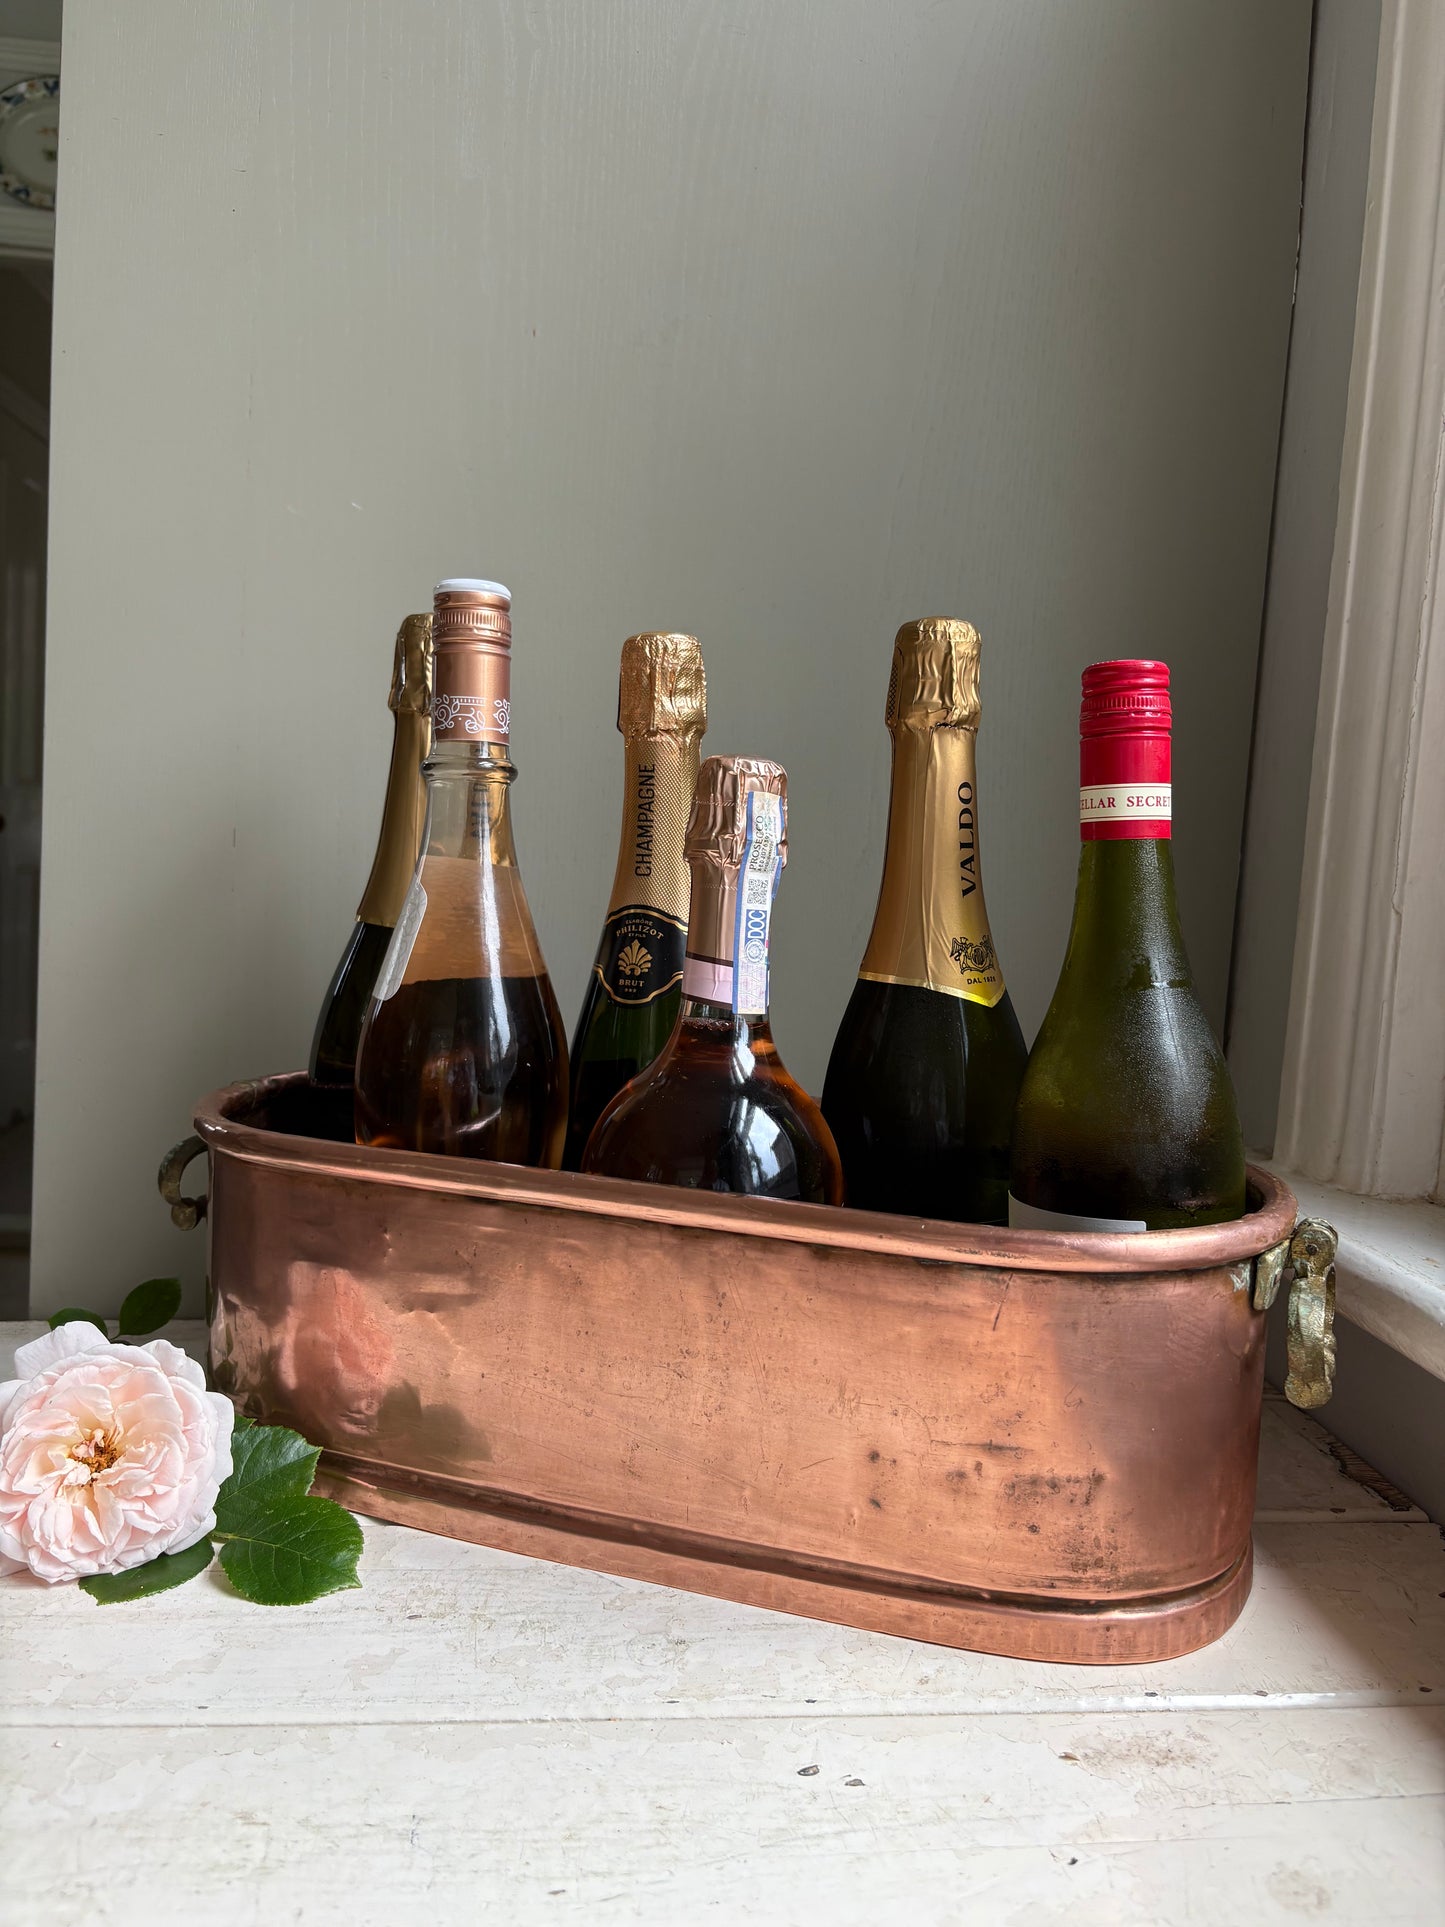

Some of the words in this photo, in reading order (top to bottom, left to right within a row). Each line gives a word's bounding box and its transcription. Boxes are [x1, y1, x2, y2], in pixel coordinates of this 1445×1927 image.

[1080, 796, 1116, 810] ELLAR
[635, 764, 655, 877] CHAMPAGNE
[957, 781, 977, 898] VALDO
[616, 924, 664, 940] PHILIZOT
[747, 910, 766, 939] DOC
[619, 979, 645, 987] BRUT
[966, 977, 982, 985] DAL
